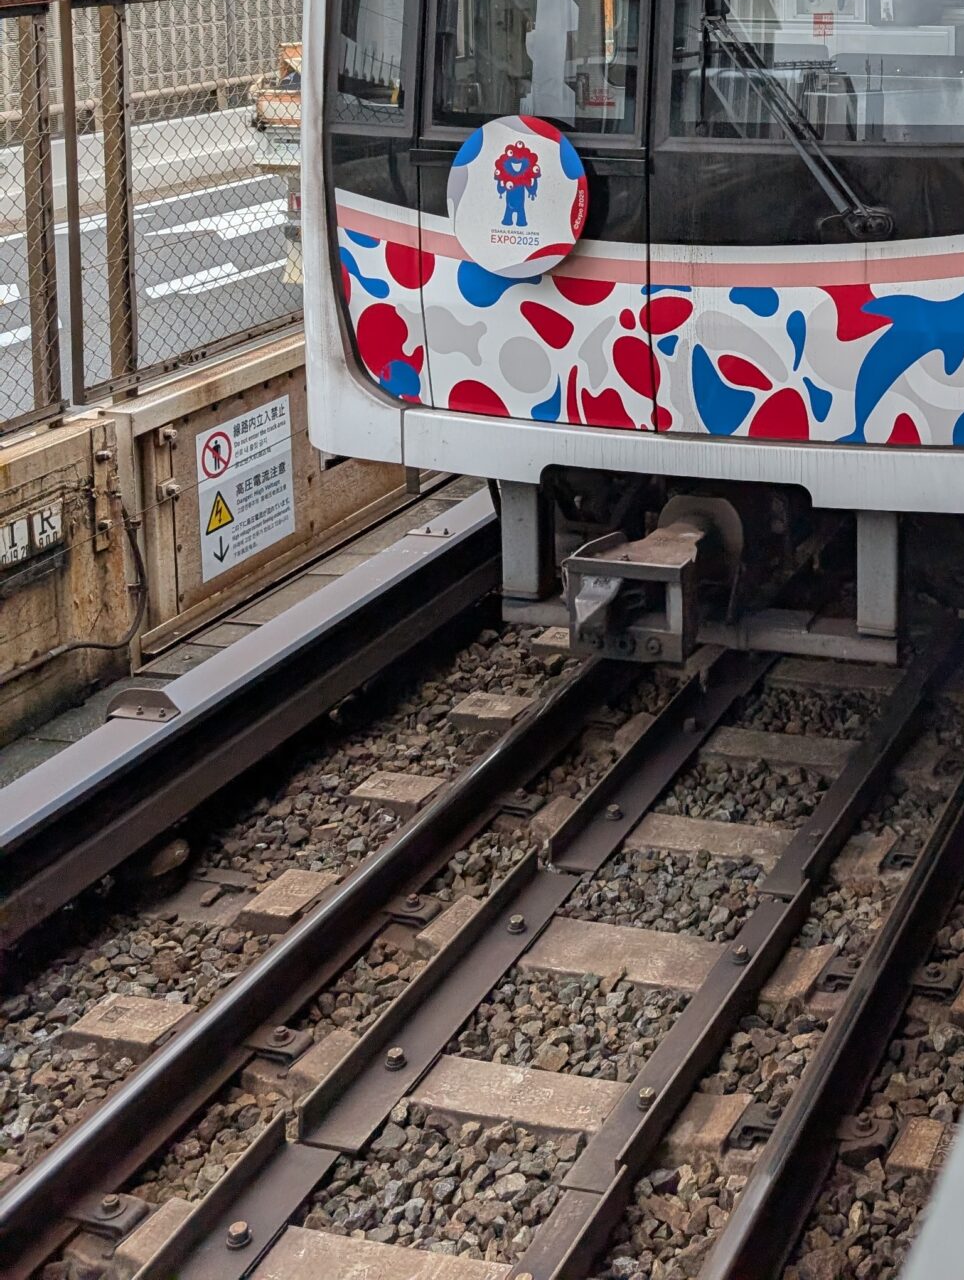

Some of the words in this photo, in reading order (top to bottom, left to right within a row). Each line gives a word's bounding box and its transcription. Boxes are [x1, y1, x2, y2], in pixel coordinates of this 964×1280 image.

[490, 235, 540, 246] EXPO2025
[233, 402, 285, 438] 線路内立入禁止
[235, 460, 285, 497] 高圧電流注意
[39, 507, 56, 536] R
